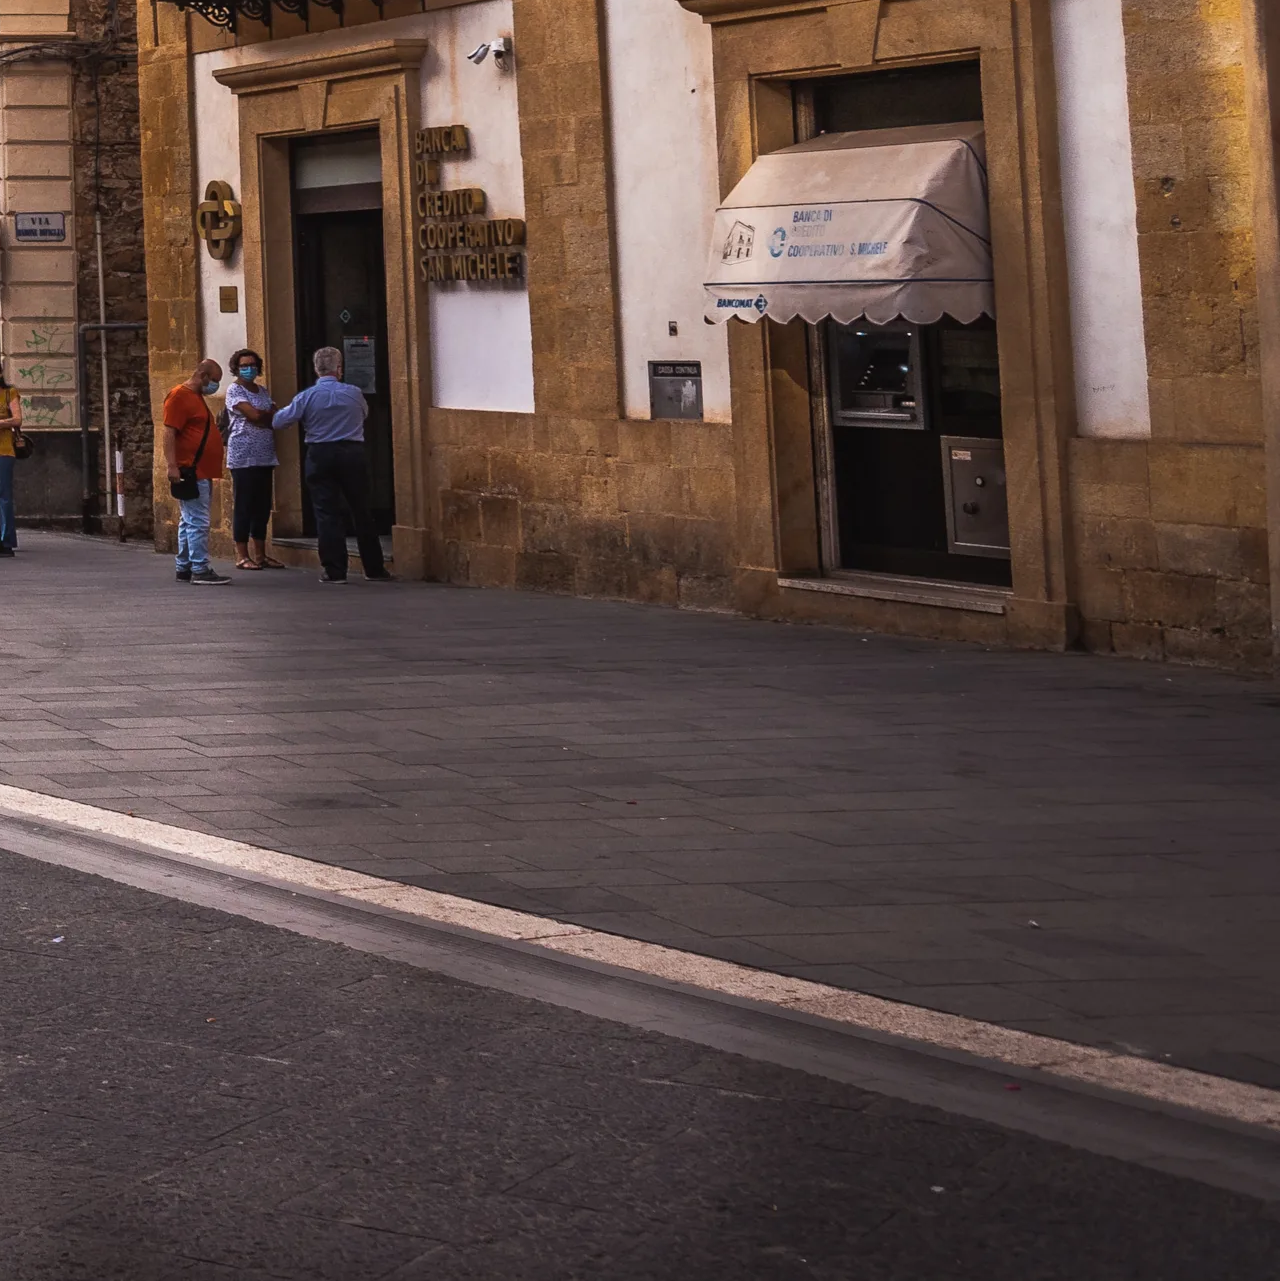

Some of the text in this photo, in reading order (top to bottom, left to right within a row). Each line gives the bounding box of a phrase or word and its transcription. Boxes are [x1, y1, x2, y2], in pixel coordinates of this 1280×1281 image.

[415, 127, 463, 154] BANCA
[415, 161, 429, 186] DI
[417, 189, 475, 218] CREDITO
[31, 217, 50, 225] VIA
[418, 220, 515, 250] COOPERATIVO
[420, 252, 514, 282] SAN MICHELE
[717, 298, 754, 308] BANCOMAT
